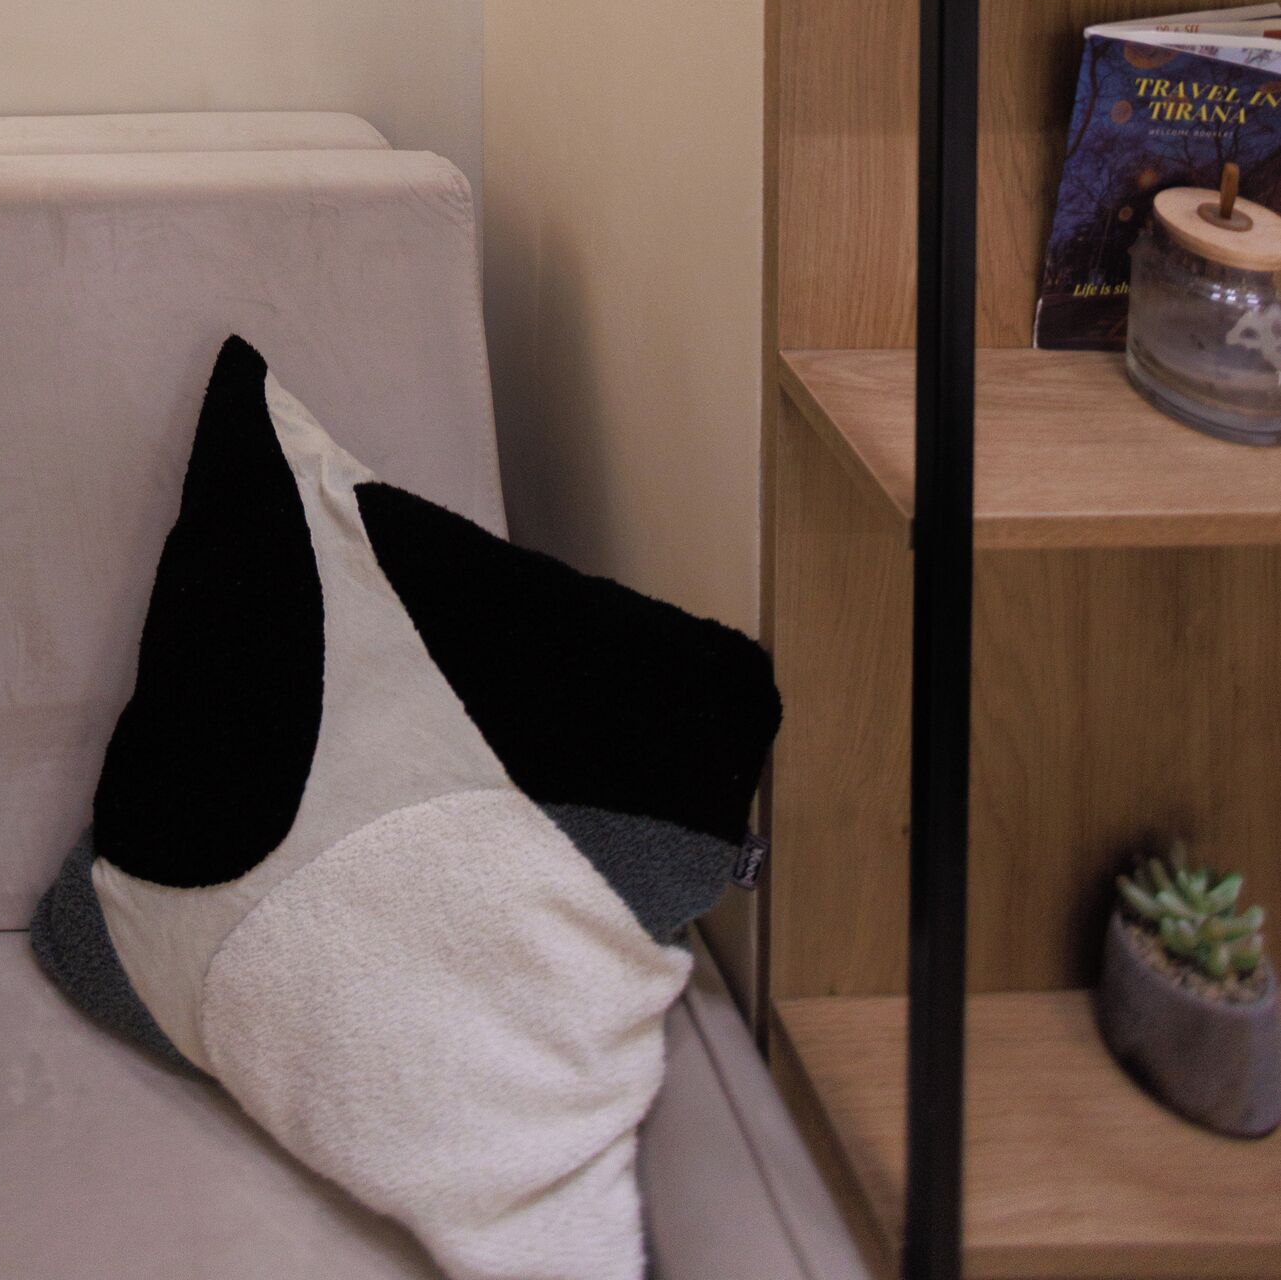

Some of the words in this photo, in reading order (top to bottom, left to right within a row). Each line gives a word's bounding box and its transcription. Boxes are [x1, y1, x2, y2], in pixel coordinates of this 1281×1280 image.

[1135, 77, 1241, 103] TRAVEL
[1249, 90, 1281, 108] IN
[1148, 101, 1247, 125] TIRANA
[1148, 128, 1189, 137] WELCOME
[1073, 283, 1098, 298] Life
[1100, 282, 1111, 296] is
